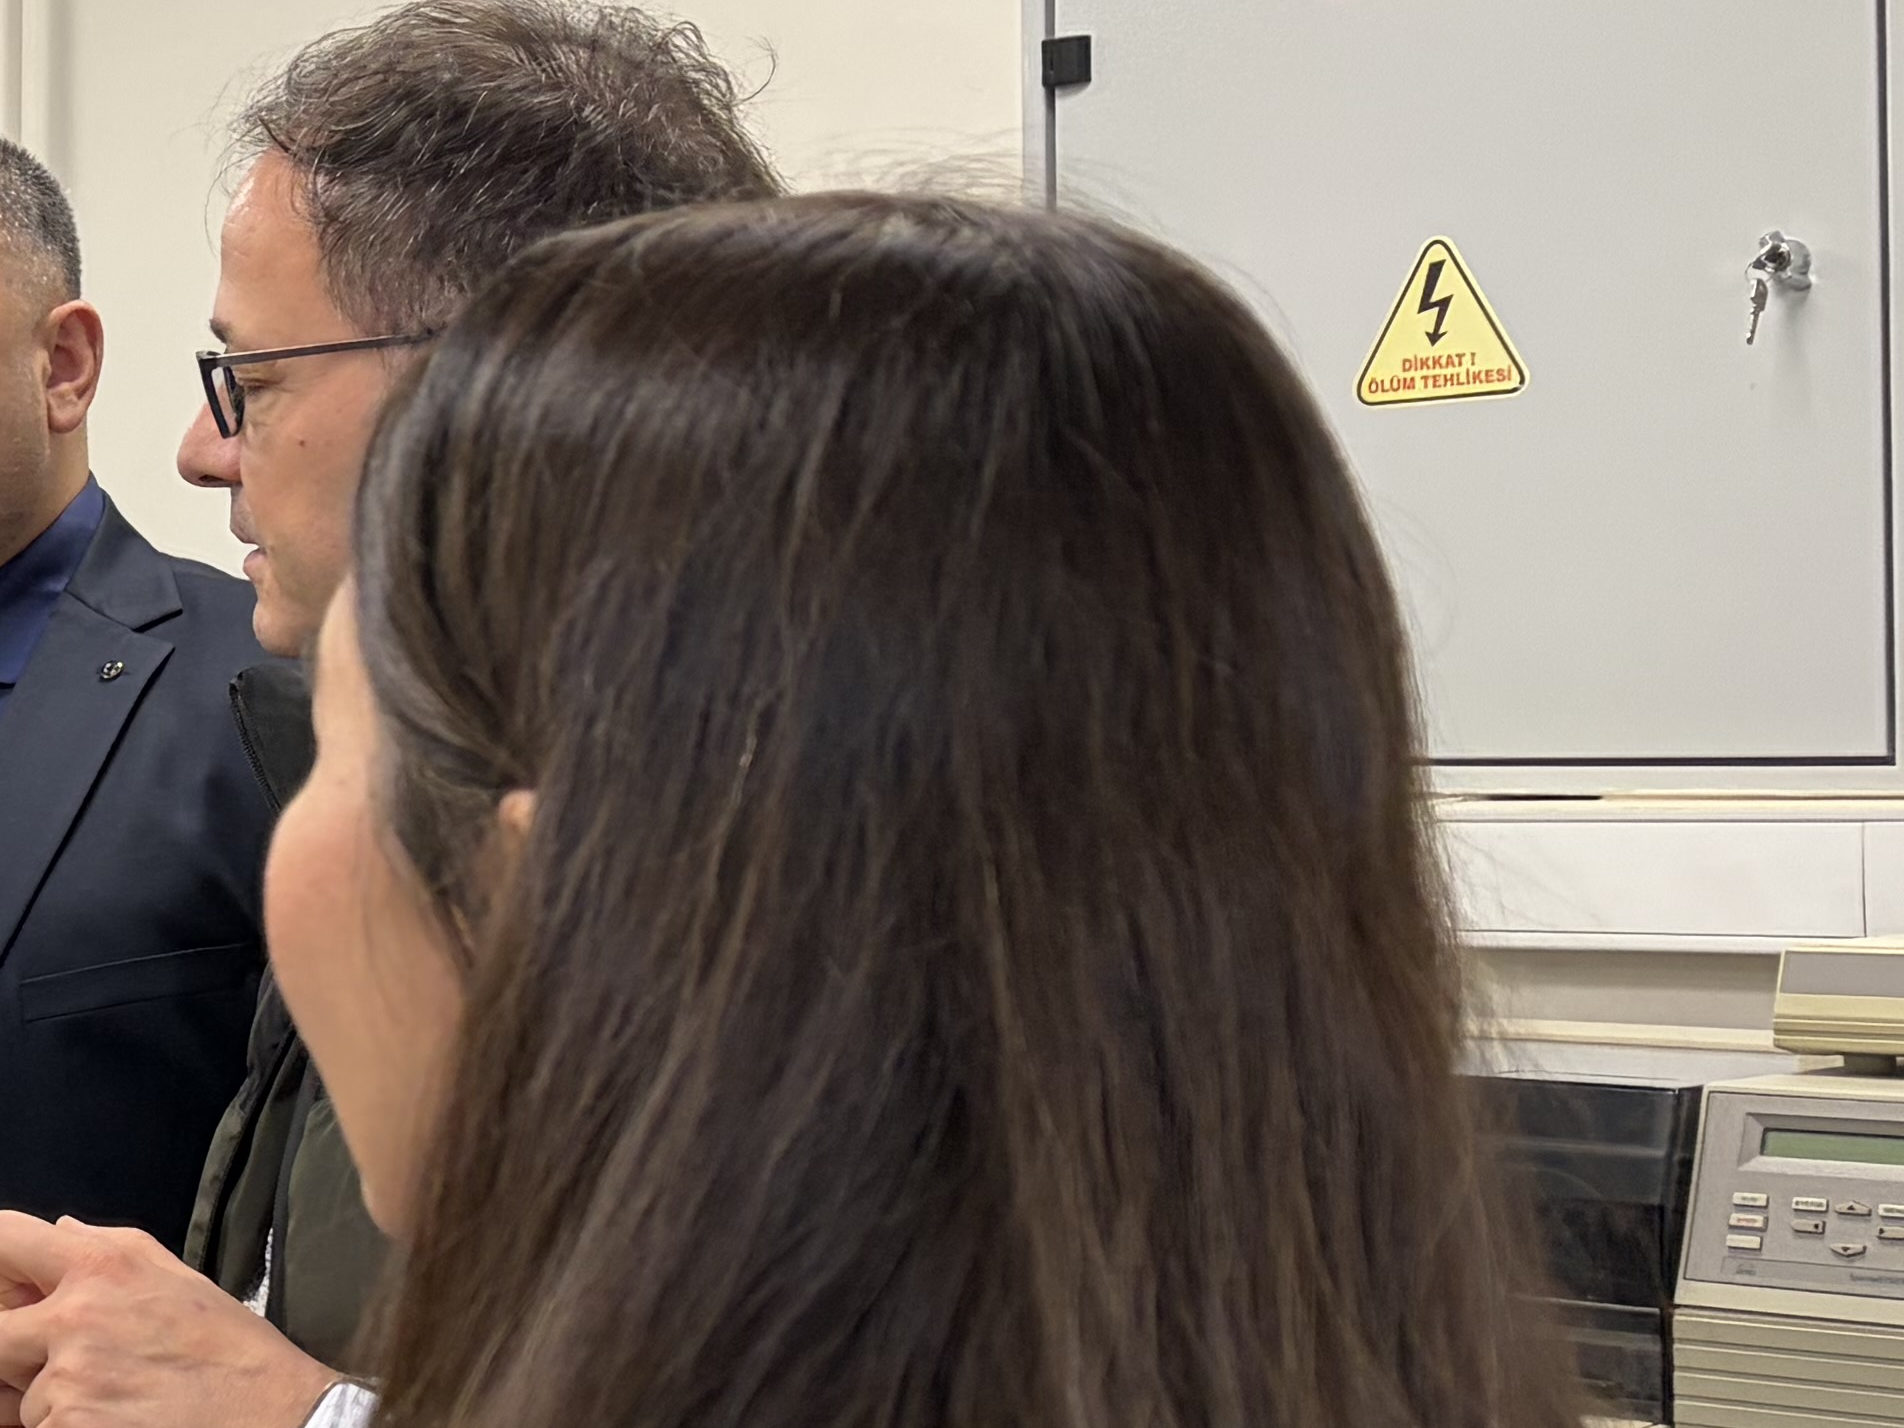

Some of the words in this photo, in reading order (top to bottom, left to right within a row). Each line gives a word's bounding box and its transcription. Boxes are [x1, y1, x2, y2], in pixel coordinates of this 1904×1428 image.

[1402, 353, 1466, 372] DİKKAT
[1368, 374, 1416, 393] ÖLÜM
[1420, 364, 1513, 389] TEHLİKESİ
